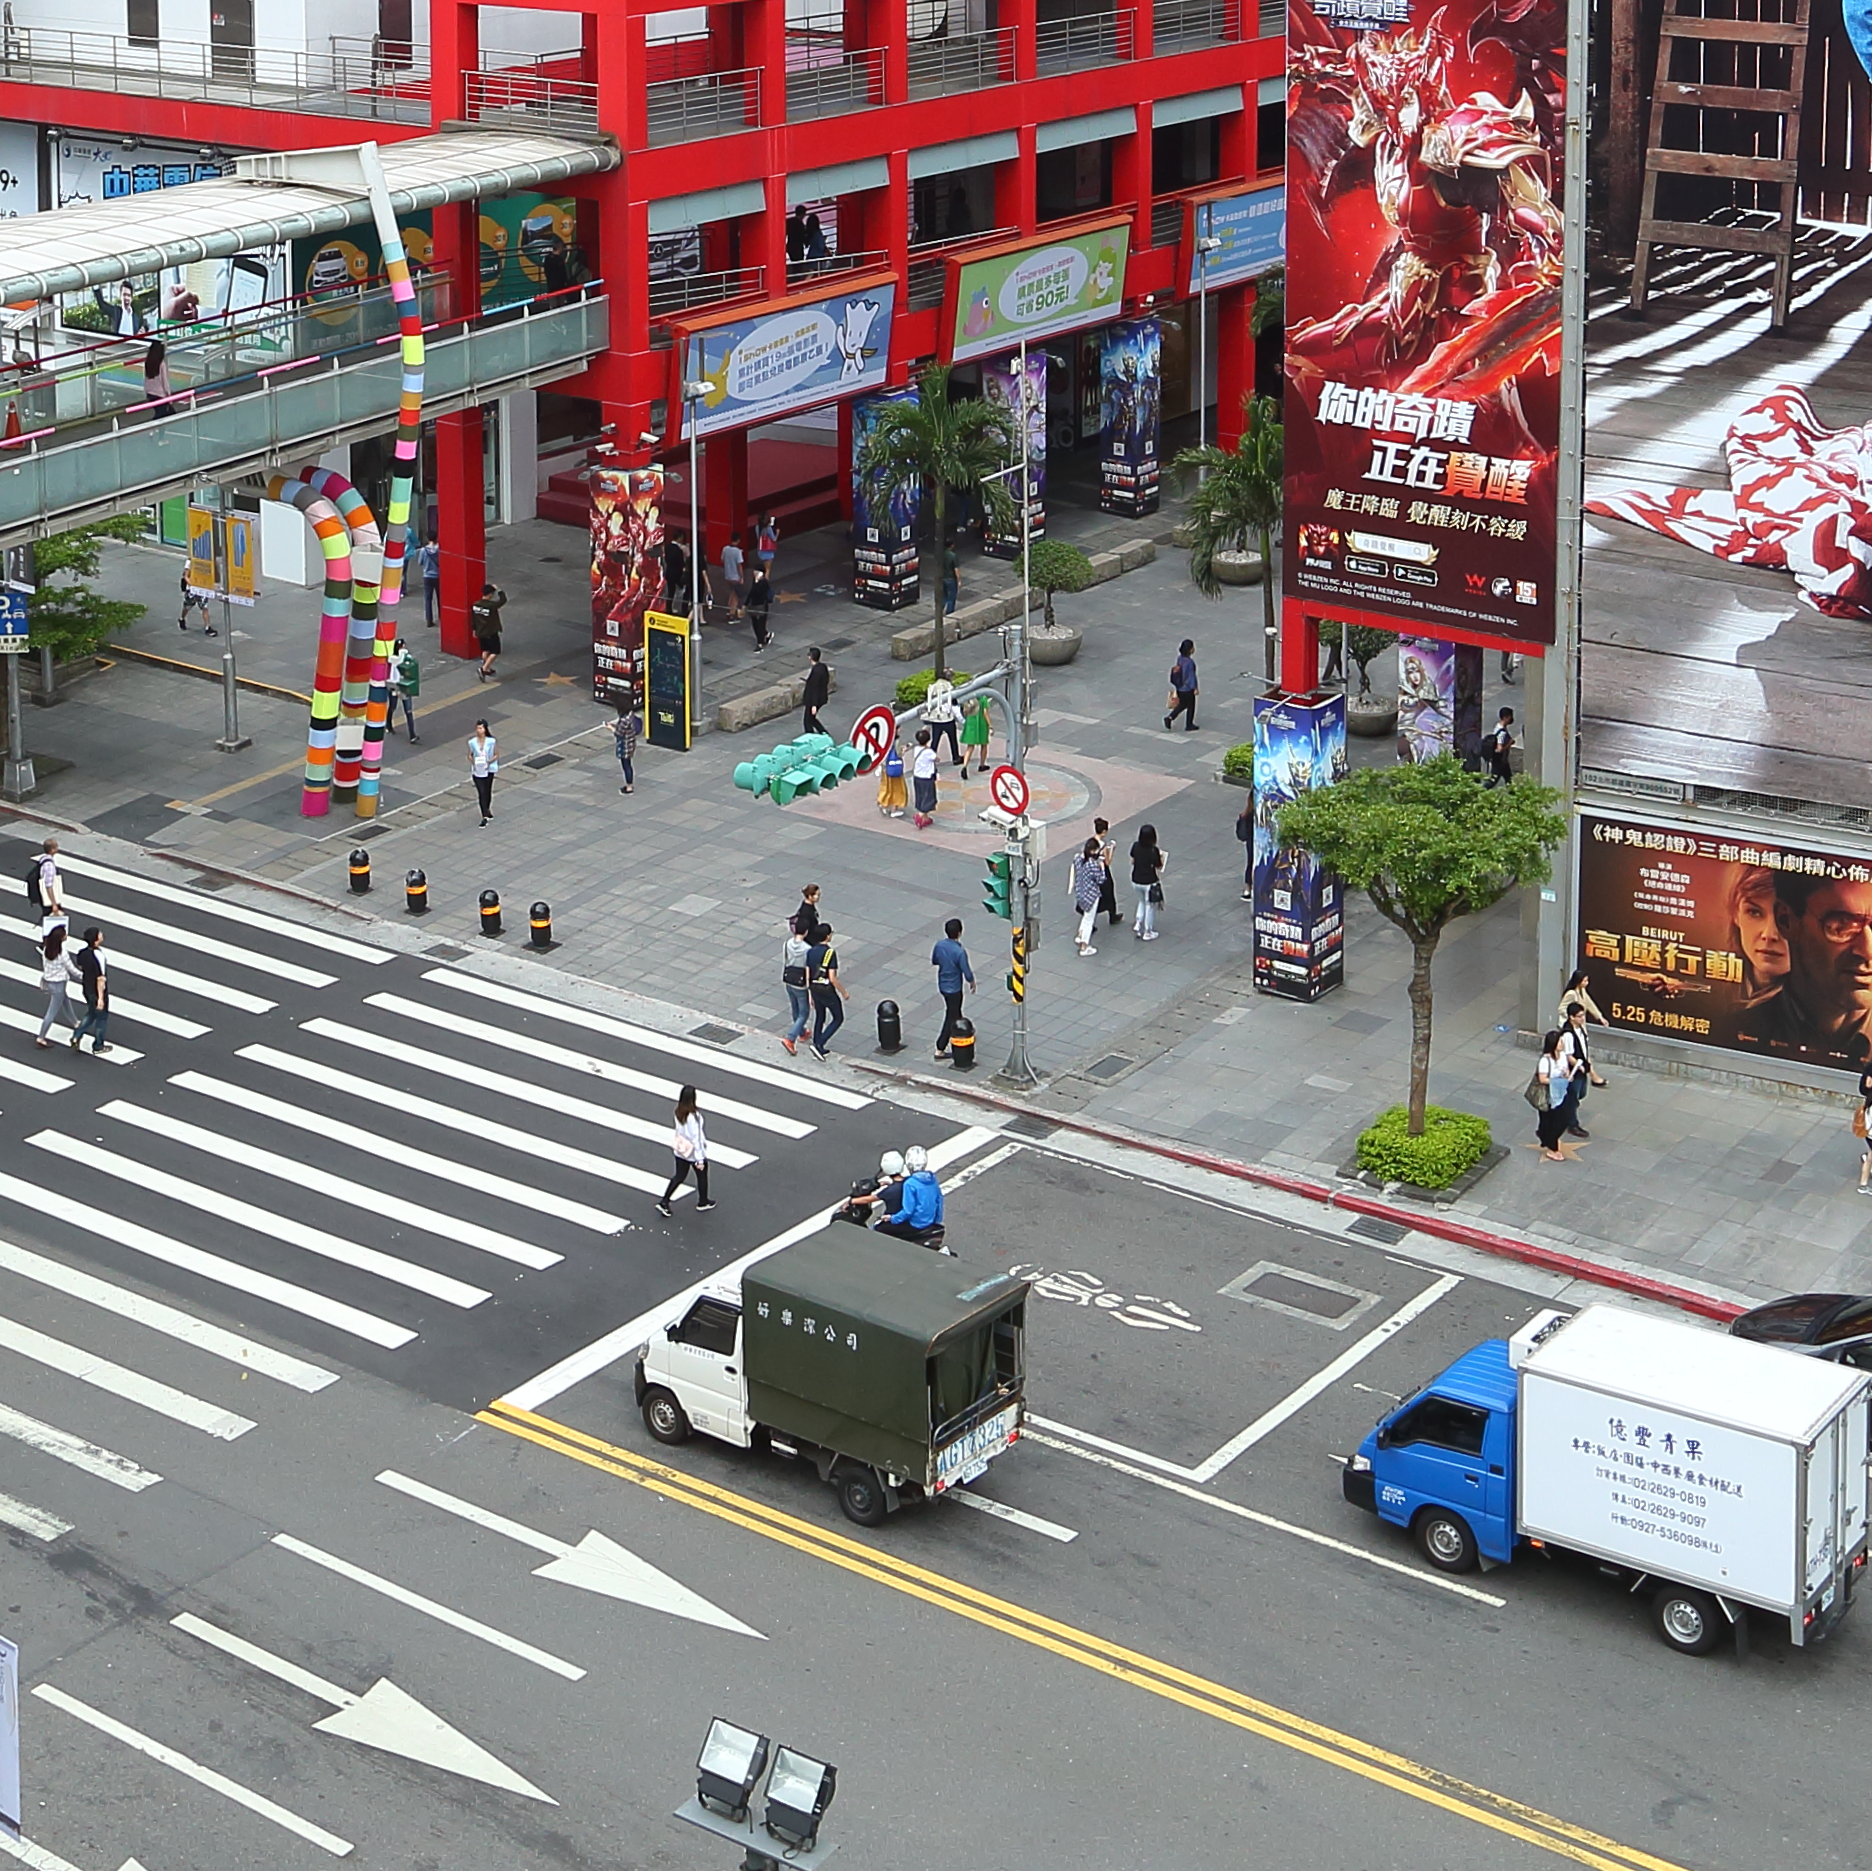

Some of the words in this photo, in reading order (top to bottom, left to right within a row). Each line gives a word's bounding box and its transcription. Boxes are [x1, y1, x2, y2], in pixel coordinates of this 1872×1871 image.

[1316, 380, 1476, 446] 你的奇蹟
[1363, 437, 1535, 505] 正在覺醒
[1324, 489, 1401, 519] 魔王降臨
[1406, 500, 1528, 541] 覺醒刻不容緩
[1585, 929, 1743, 984] 高壓行動
[1642, 926, 1685, 943] BEIRUT
[1611, 1002, 1645, 1023] 5.25
[1648, 1010, 1711, 1035] 危機解密
[1609, 1417, 1703, 1461] 億豐青果
